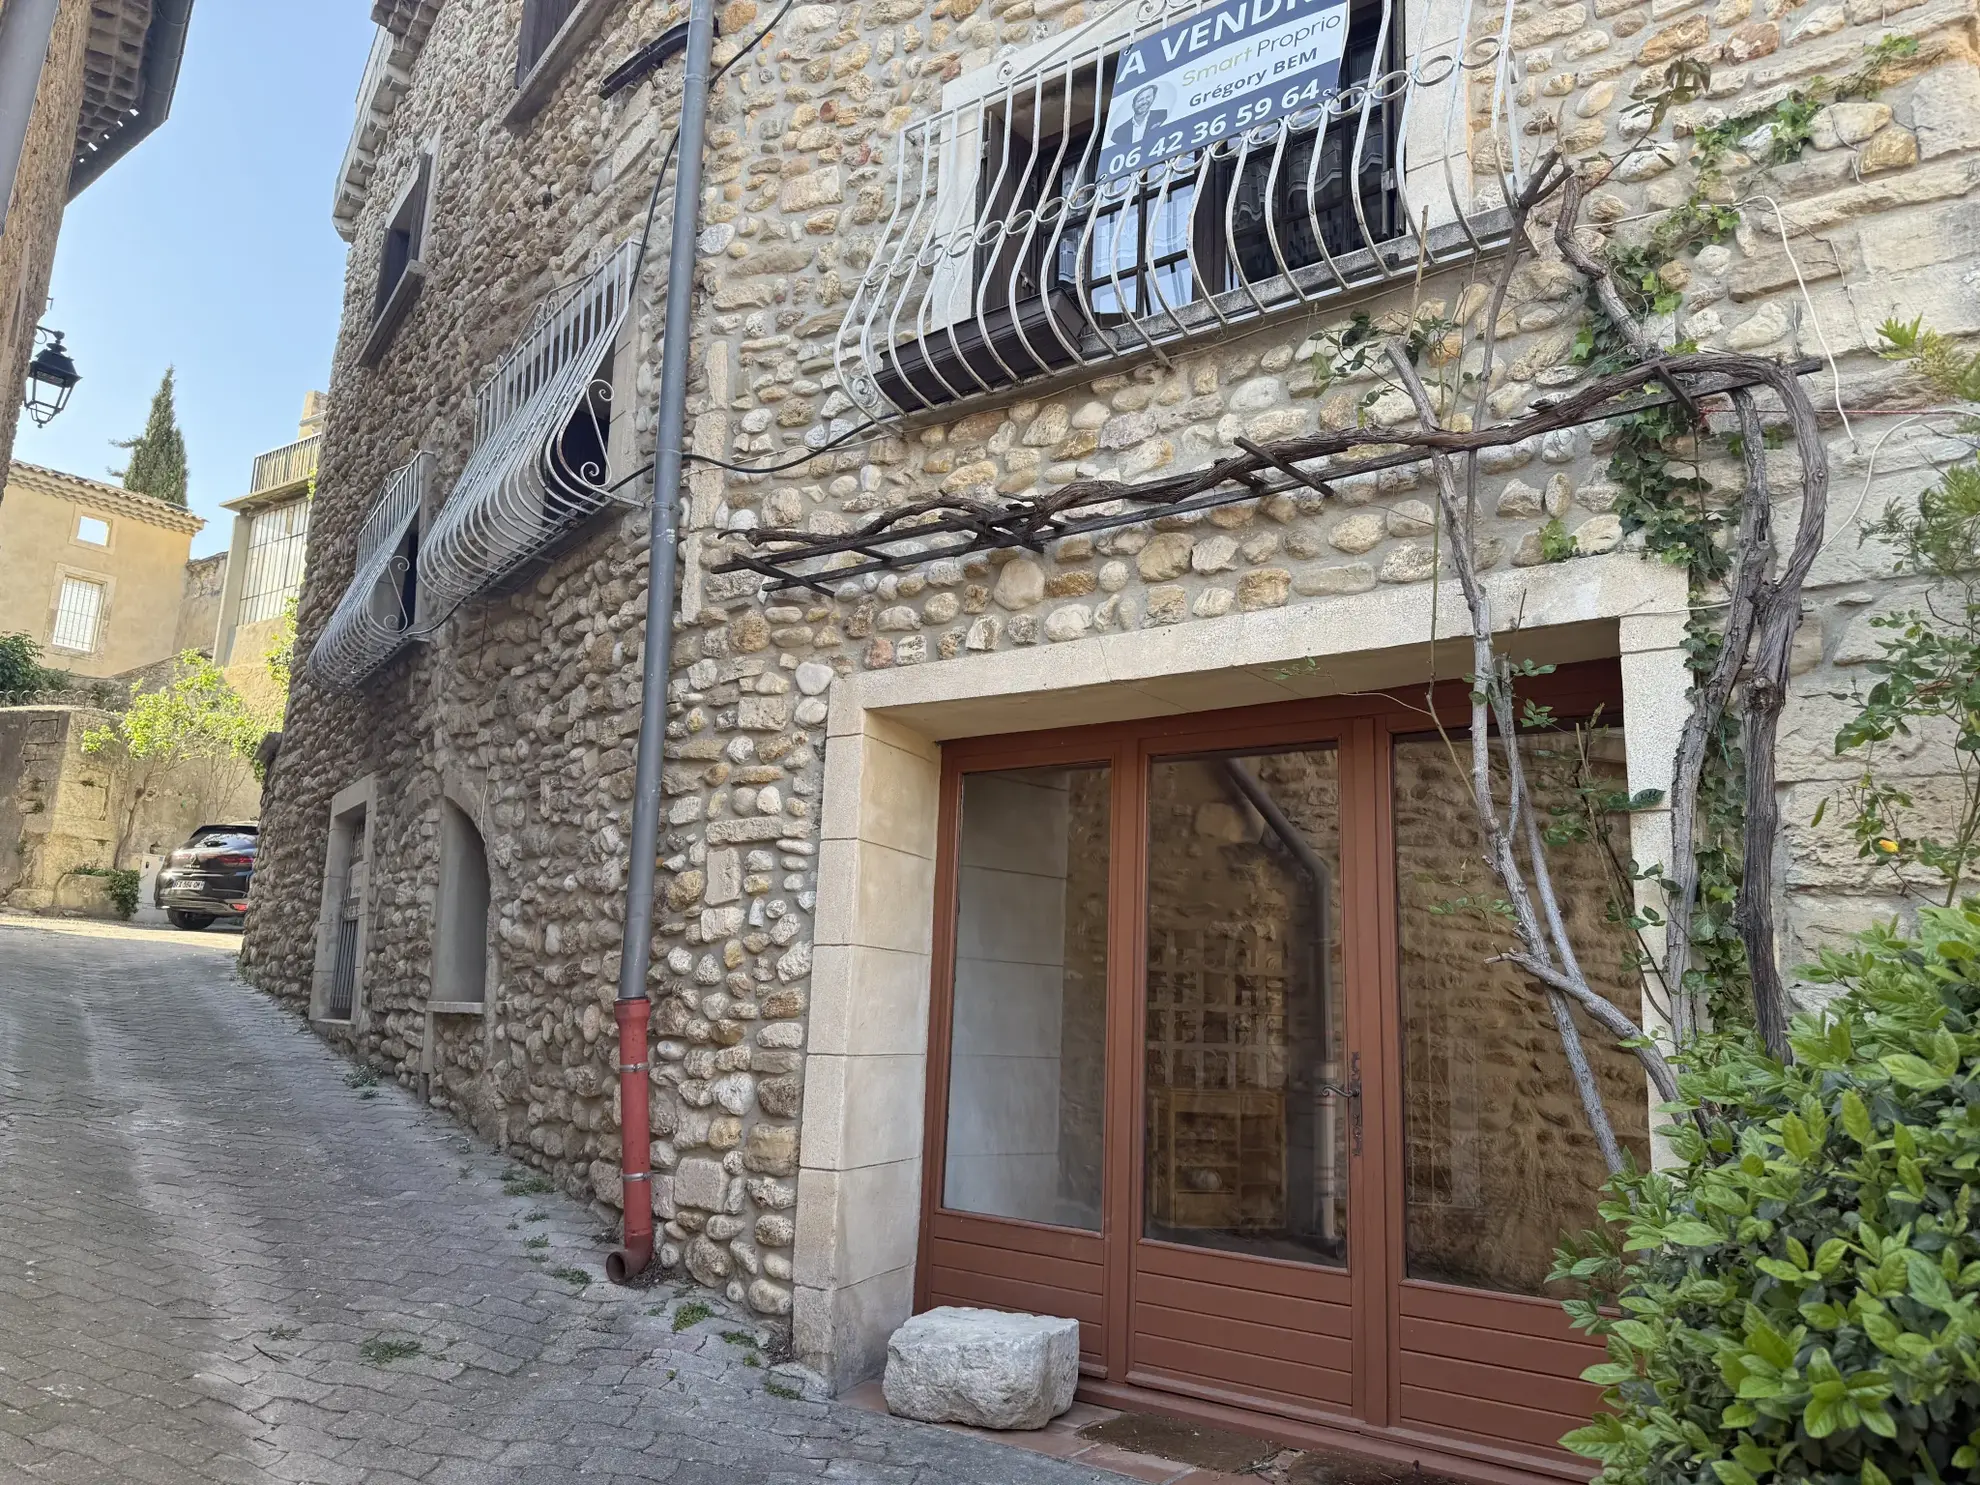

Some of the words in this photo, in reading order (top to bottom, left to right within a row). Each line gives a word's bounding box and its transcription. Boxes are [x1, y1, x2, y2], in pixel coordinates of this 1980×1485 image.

[1117, 50, 1146, 84] A
[1182, 47, 1252, 87] Smart
[1256, 15, 1341, 58] Proprio
[1189, 68, 1267, 107] Grégory
[1273, 47, 1318, 74] BEM
[1109, 146, 1142, 175] 06
[1148, 131, 1184, 158] 42
[1190, 113, 1226, 144] 36
[1235, 97, 1272, 128] 59
[1281, 78, 1319, 109] 64
